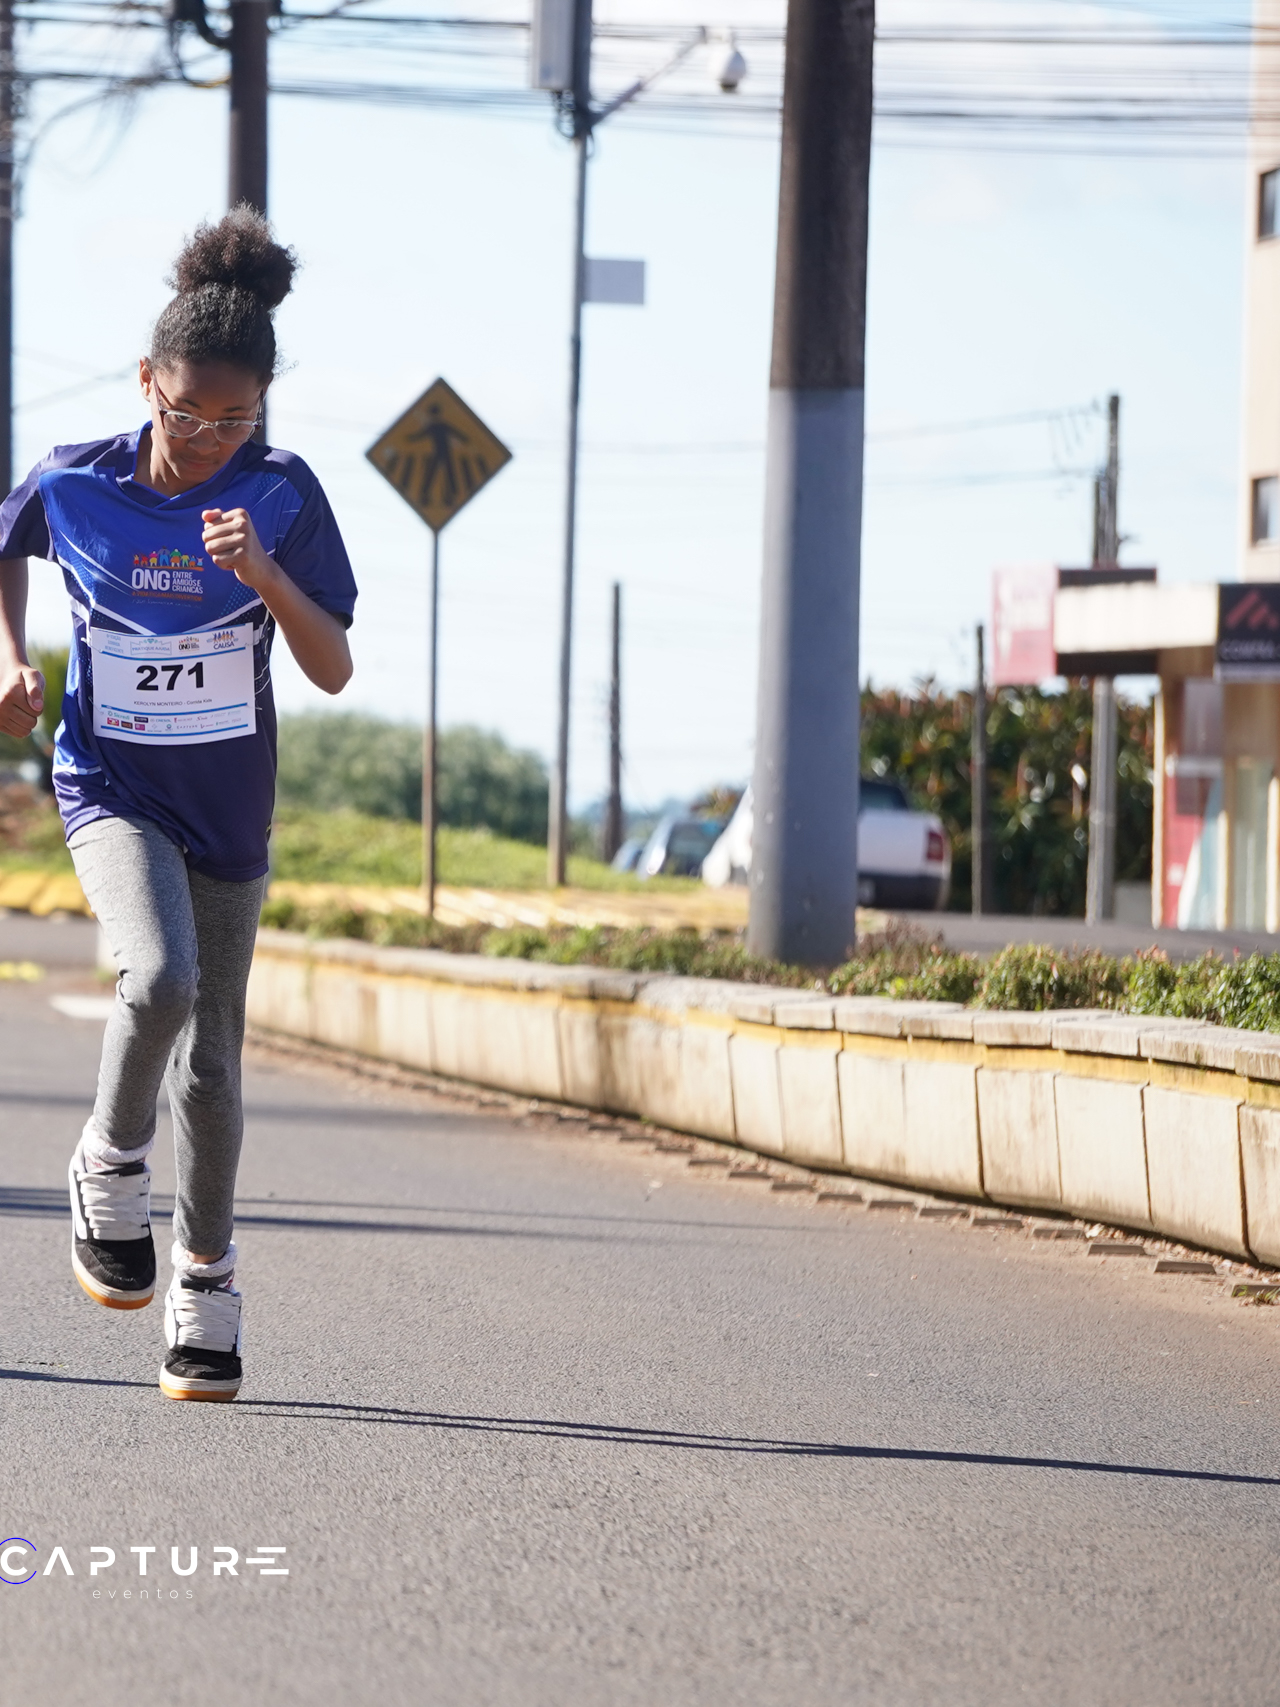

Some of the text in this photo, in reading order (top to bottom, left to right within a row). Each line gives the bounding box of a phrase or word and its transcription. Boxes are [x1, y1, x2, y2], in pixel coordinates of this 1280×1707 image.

[131, 568, 171, 591] ONG
[172, 571, 193, 579] ENTRE
[213, 641, 235, 650] CAUSA
[136, 661, 204, 691] 271
